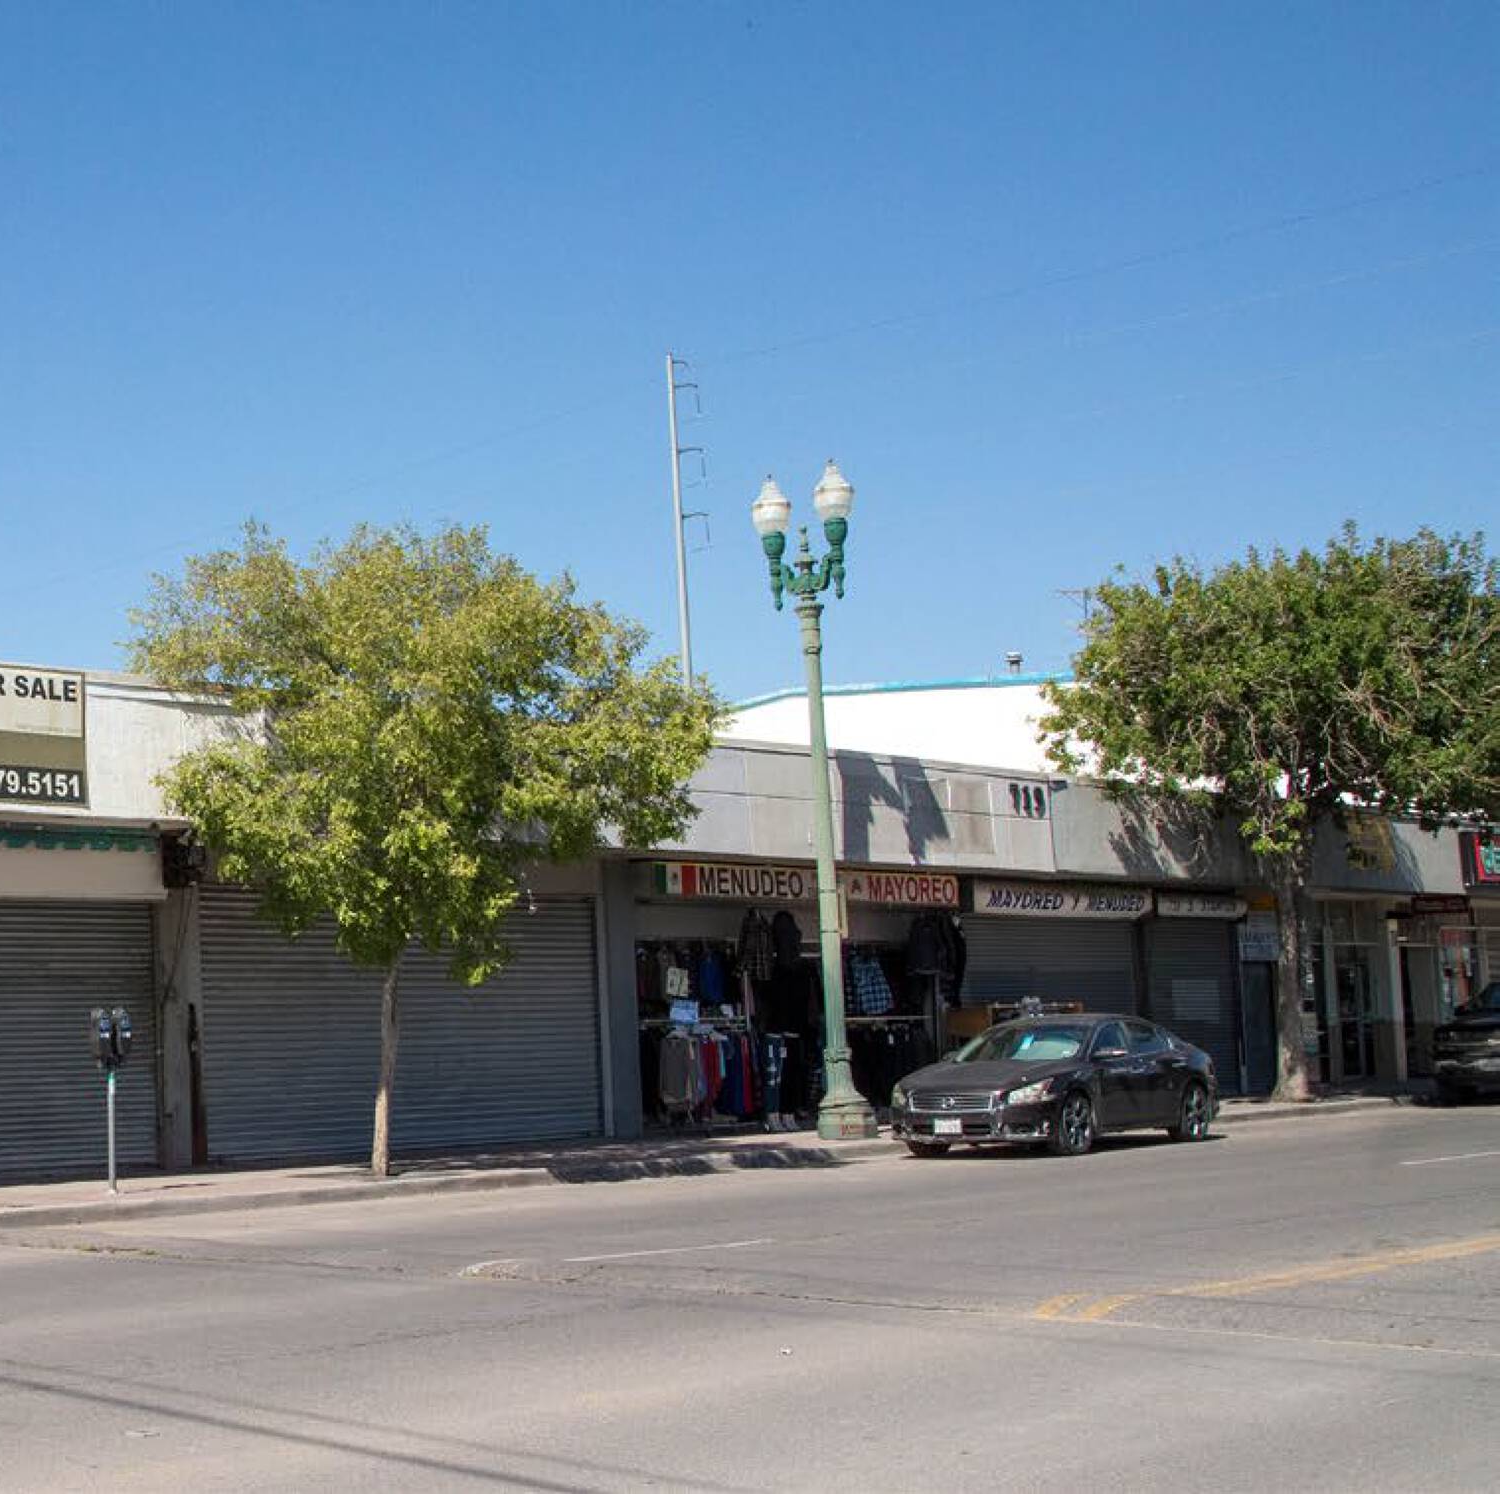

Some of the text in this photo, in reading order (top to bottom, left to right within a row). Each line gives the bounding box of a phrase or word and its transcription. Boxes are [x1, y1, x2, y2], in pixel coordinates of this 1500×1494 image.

[14, 675, 78, 702] SALE
[699, 866, 804, 898] MENUDEO
[867, 875, 957, 903] MAYOREO
